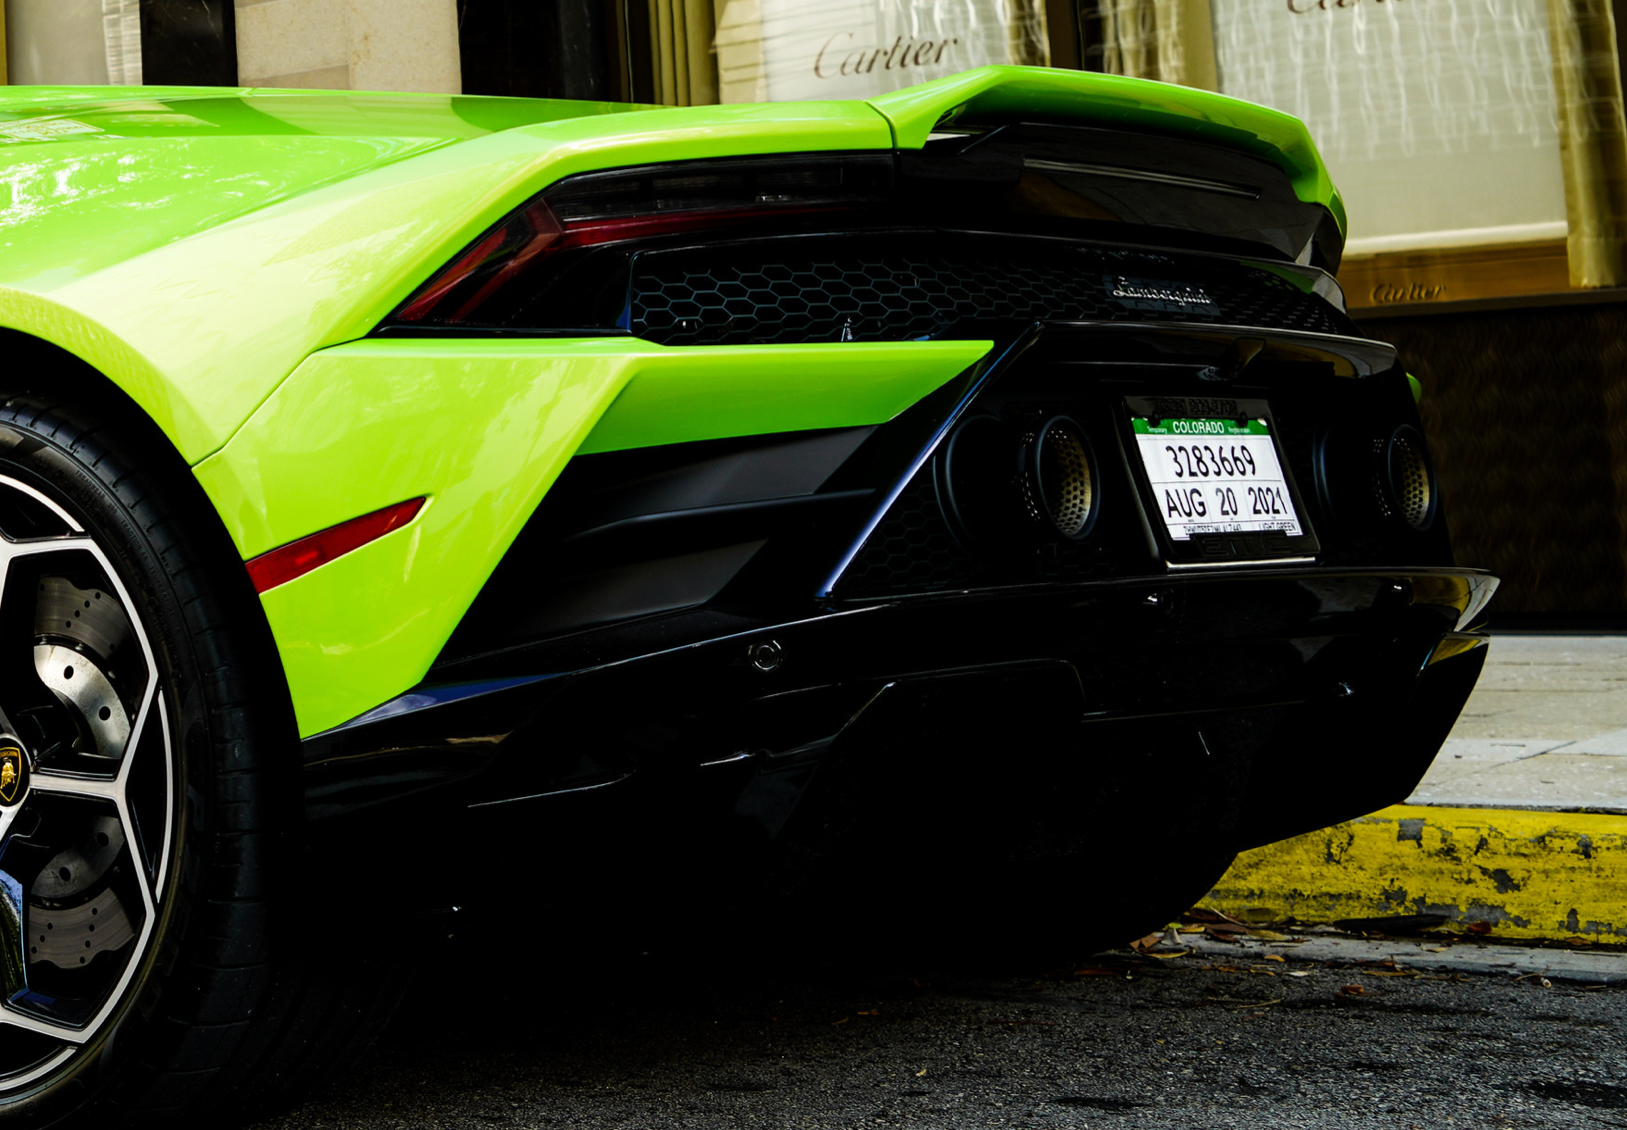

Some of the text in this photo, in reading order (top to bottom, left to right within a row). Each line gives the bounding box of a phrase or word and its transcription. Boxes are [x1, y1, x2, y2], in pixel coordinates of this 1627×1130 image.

[813, 32, 959, 81] Cartier
[1113, 276, 1212, 306] Lamborghini
[1371, 282, 1447, 304] Cartier
[1173, 421, 1224, 434] COLORADO
[1165, 445, 1256, 478] 3283669
[1165, 486, 1288, 518] AUG 20 2021
